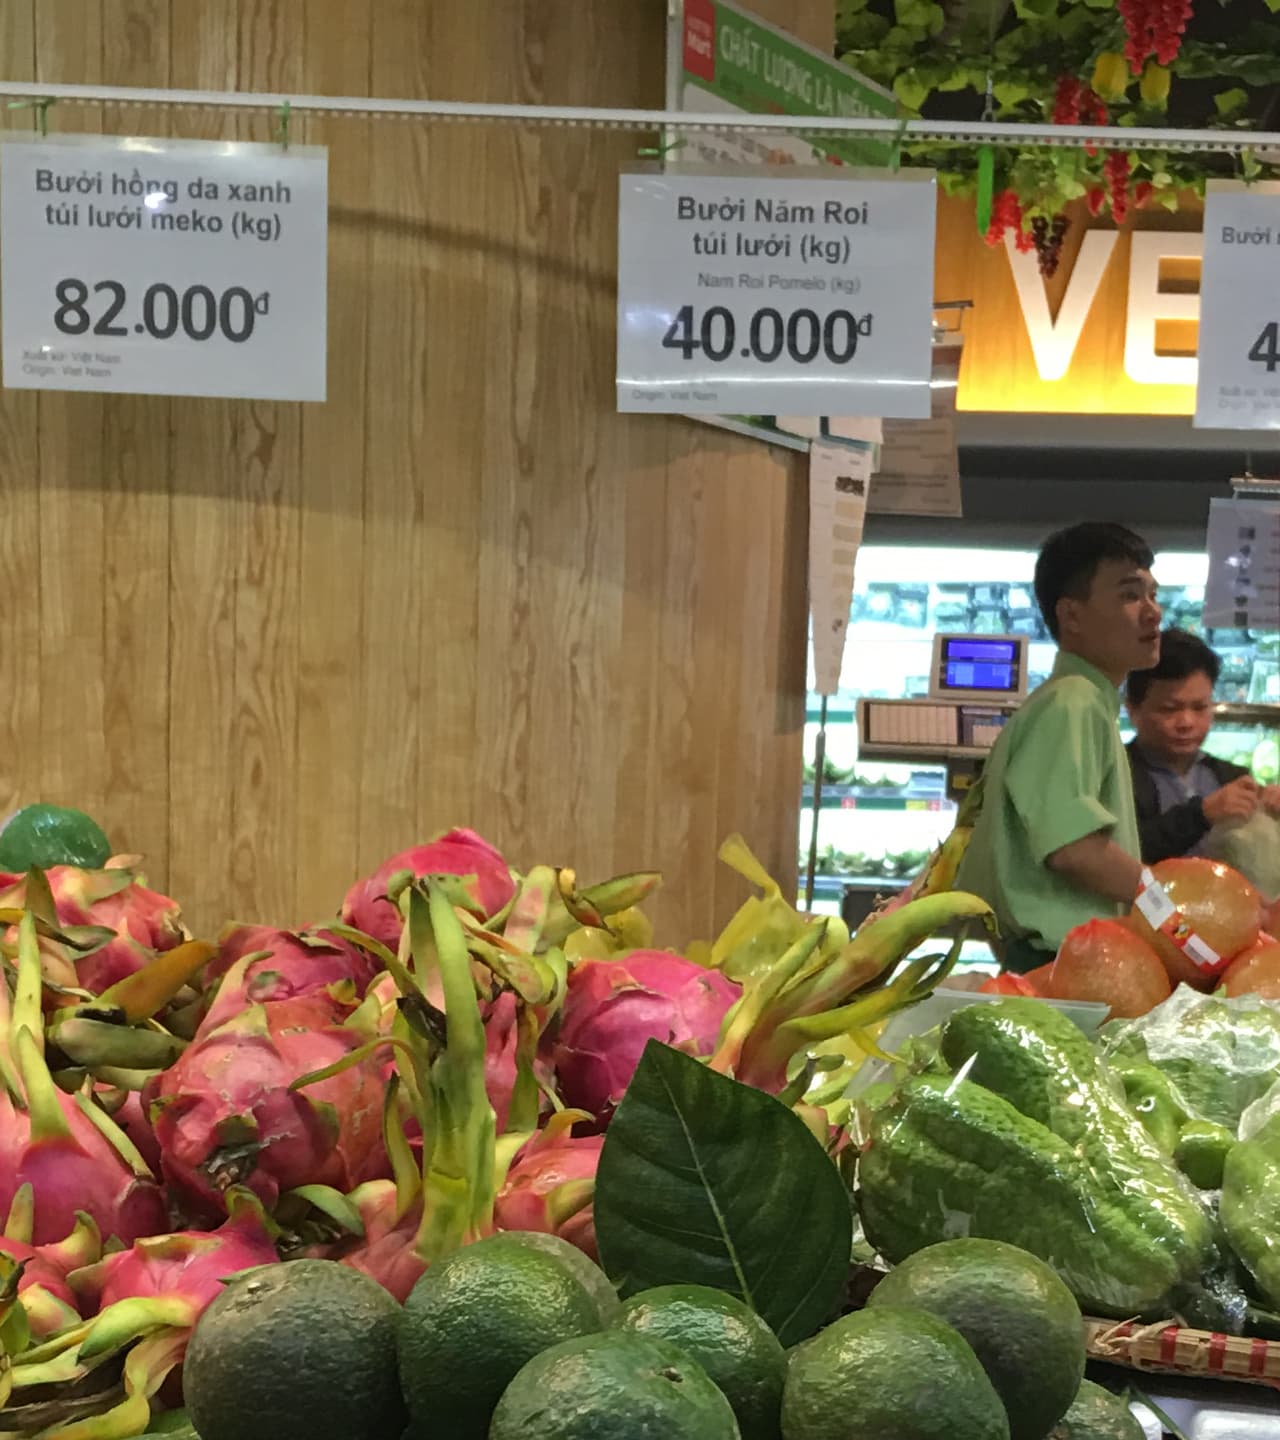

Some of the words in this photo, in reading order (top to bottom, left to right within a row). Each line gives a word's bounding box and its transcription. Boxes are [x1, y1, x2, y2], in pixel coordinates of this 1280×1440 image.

[187, 178, 219, 201] da
[227, 181, 292, 204] xanh
[45, 201, 79, 227] túi
[151, 209, 224, 234] meko
[231, 212, 282, 241] (kg)
[754, 199, 814, 225] Năm
[823, 200, 870, 226] Roi
[693, 229, 728, 257] túi
[800, 235, 851, 265] (kg)
